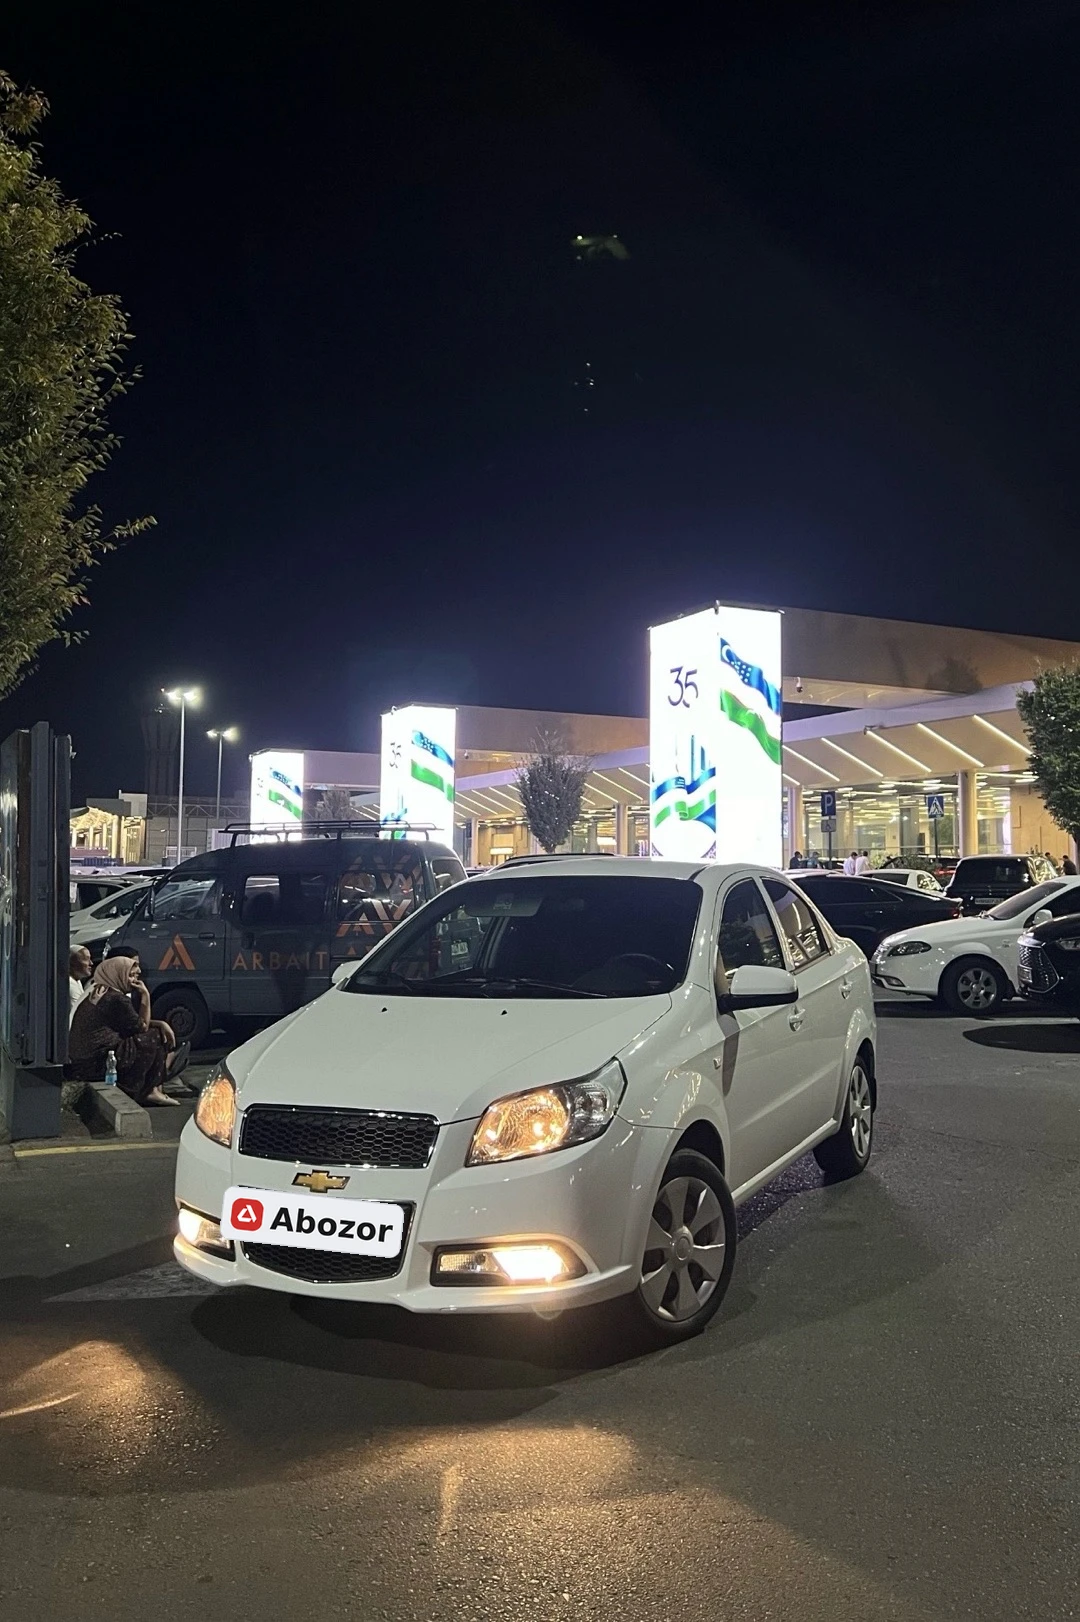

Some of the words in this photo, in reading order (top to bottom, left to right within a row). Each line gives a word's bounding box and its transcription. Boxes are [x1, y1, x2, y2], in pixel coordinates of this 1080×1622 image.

[668, 666, 699, 708] 35
[824, 794, 834, 814] P
[232, 951, 328, 971] ARBAIT
